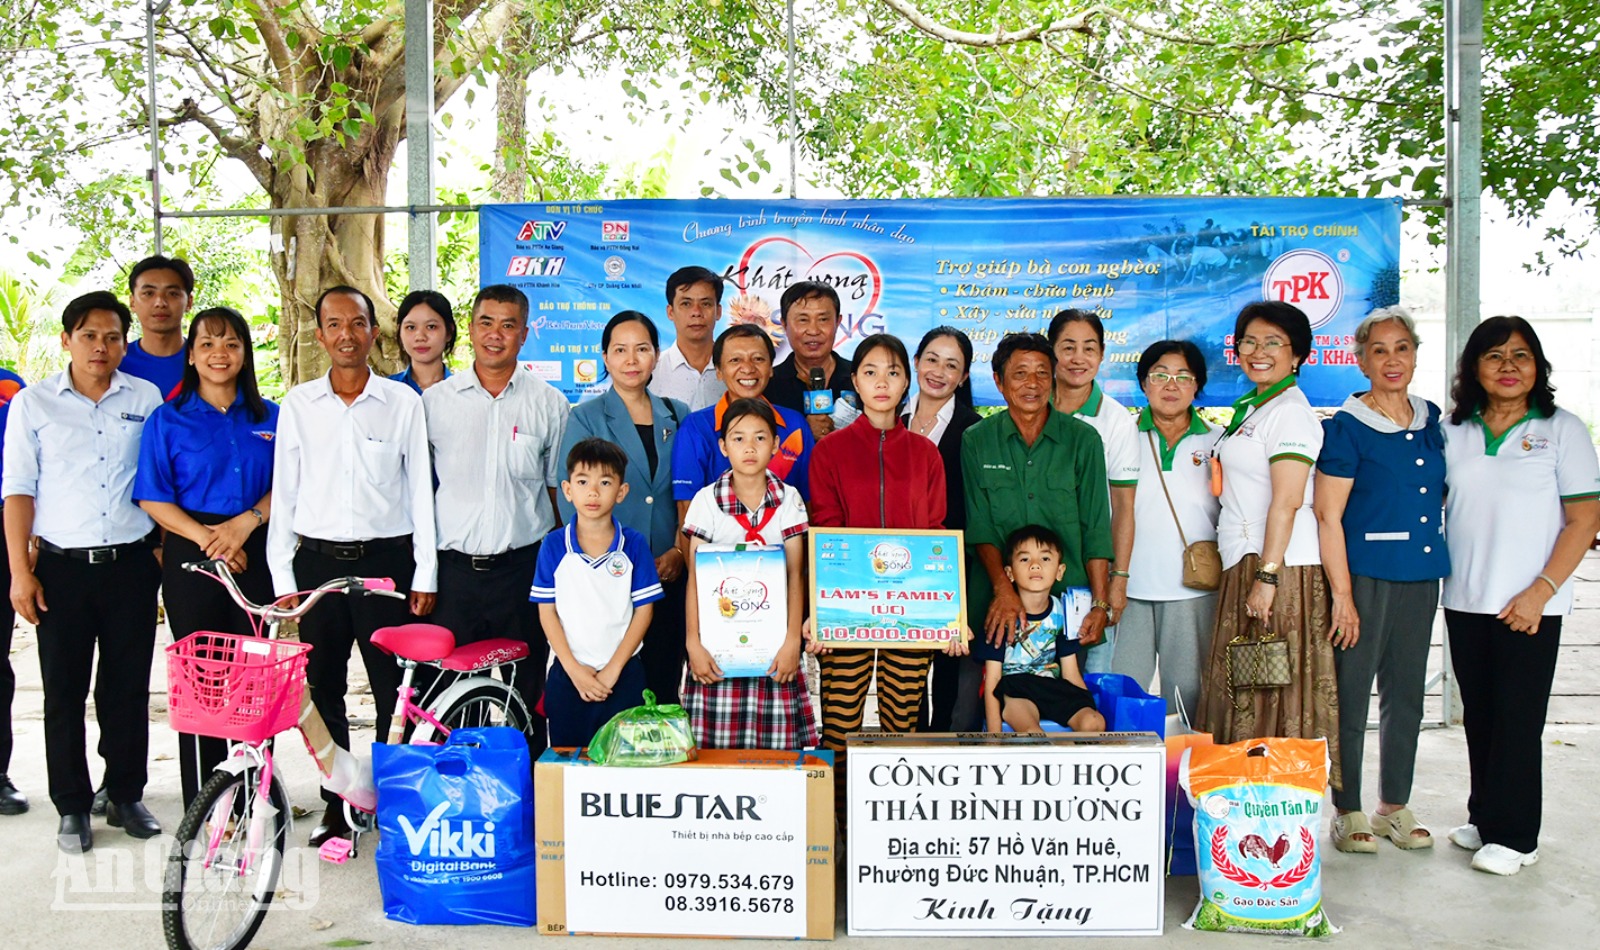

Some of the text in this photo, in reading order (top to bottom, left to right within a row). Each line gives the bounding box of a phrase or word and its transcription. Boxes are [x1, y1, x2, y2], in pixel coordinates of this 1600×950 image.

[516, 221, 568, 240] ATV
[739, 209, 767, 229] trình
[773, 210, 813, 229] truyền
[820, 208, 847, 227] hình
[852, 214, 885, 235] nhân
[1250, 223, 1358, 240] TÀI TRỢ CHÍNH
[721, 264, 795, 291] Khát
[936, 259, 1162, 280] Trợ giúp bà con nghèo:
[954, 285, 1009, 297] Khám
[1023, 283, 1067, 298] chữa
[1072, 284, 1115, 301] bệnh
[1272, 272, 1330, 303] TPK
[539, 300, 554, 310] BẢO
[954, 305, 990, 323] Xây
[1005, 304, 1037, 319] sửa
[770, 309, 885, 339] SNG
[550, 343, 565, 353] BẢO
[1315, 335, 1330, 345] TM
[1333, 336, 1340, 345] &
[820, 588, 955, 601] LÂM'S FAMILY
[871, 603, 905, 615] (ÚC)
[869, 757, 1142, 792] CÔNG TY DU HỌC
[581, 792, 762, 821] BLUESTAR
[865, 792, 1143, 822] THÁI BÌNH DƯƠNG
[1280, 799, 1302, 815] Tân
[397, 800, 495, 858] Vikki
[672, 830, 697, 840] Thiết
[699, 830, 709, 842] bị
[712, 831, 730, 840] nhà
[733, 831, 752, 842] bếp
[776, 831, 794, 842] cấp
[888, 832, 1121, 860] Địa chỉ: 57 Hồ Văn Huê,
[411, 860, 496, 874] Digital Bank
[858, 864, 1149, 888] Phường Đức Nhuận, TP.HCM
[581, 870, 794, 891] Hotline: 0979.534.679
[664, 896, 795, 914] 08.3916.5678
[913, 897, 1093, 925] Kính Tặng
[1233, 896, 1298, 907] Gạo Đặc Sản
[547, 924, 565, 932] BẾP
